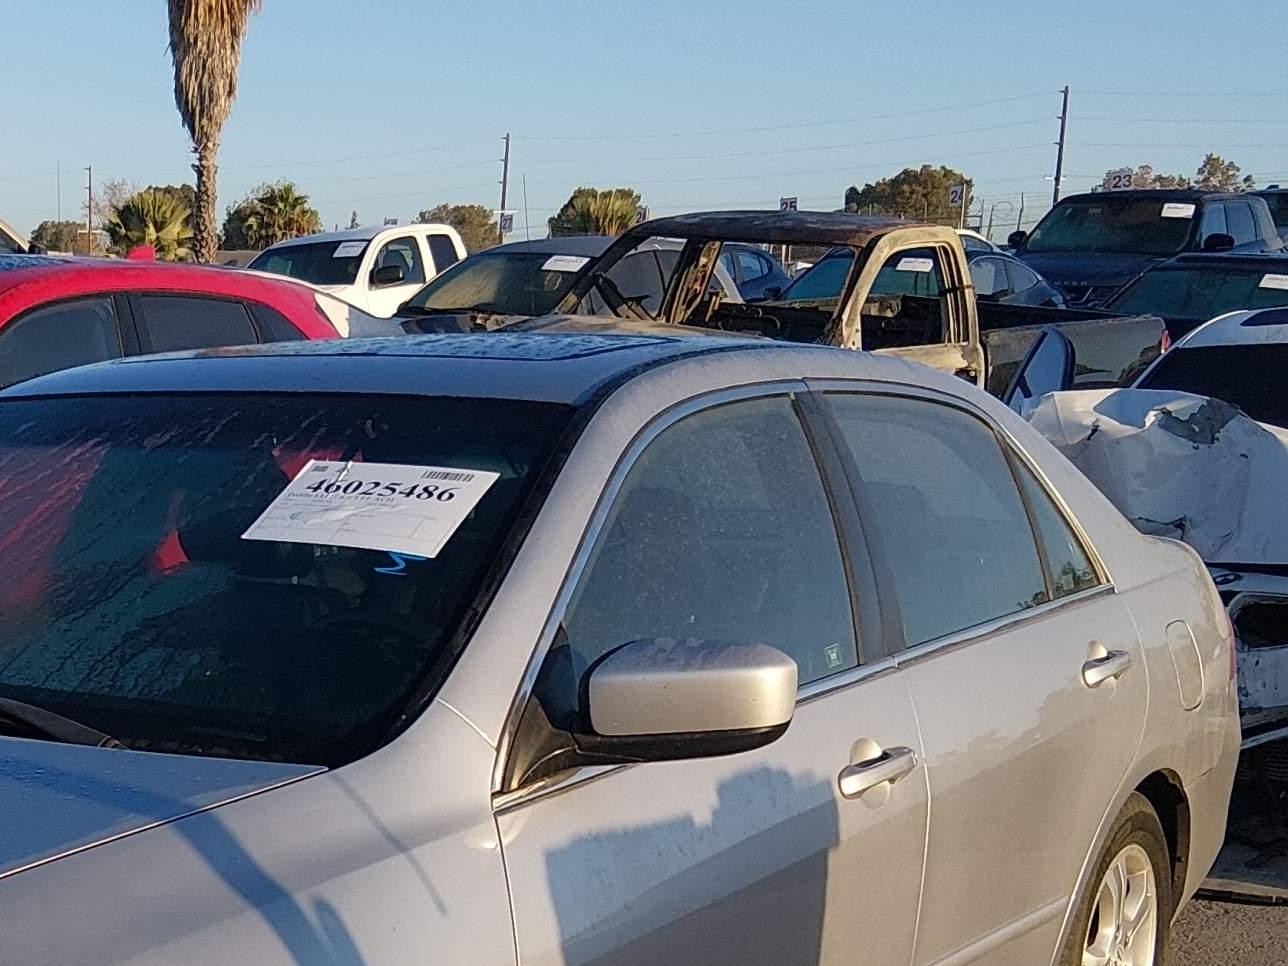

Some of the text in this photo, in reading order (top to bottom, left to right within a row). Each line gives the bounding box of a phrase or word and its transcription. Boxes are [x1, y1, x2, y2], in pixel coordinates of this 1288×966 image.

[1112, 174, 1132, 188] 23
[502, 216, 513, 230] 27
[305, 478, 461, 502] 46025486
